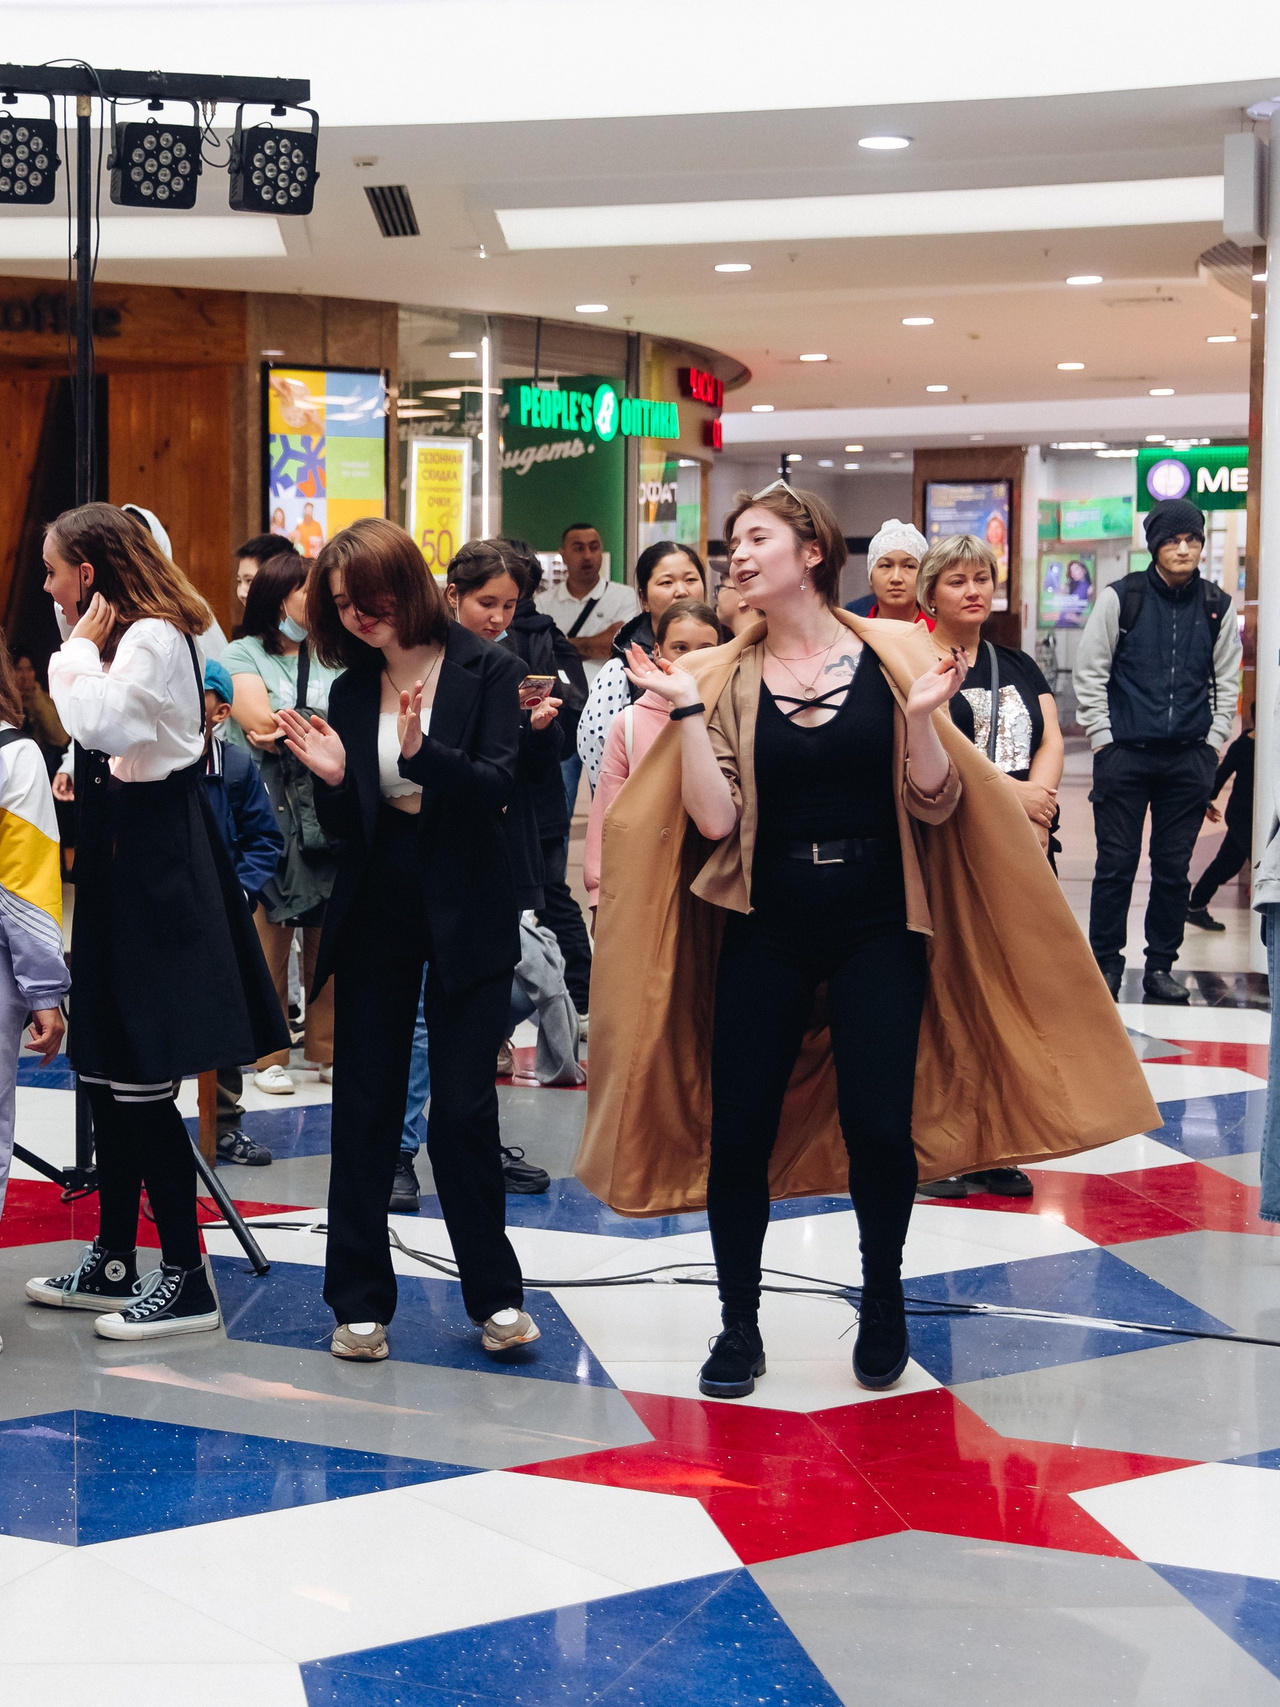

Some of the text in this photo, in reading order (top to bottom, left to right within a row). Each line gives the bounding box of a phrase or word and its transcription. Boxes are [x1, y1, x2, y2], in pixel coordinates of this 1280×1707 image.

[520, 385, 593, 433] PEOPLE'S
[621, 398, 680, 440] ОПТИКА
[1196, 466, 1249, 493] МЕ
[421, 528, 454, 569] 50
